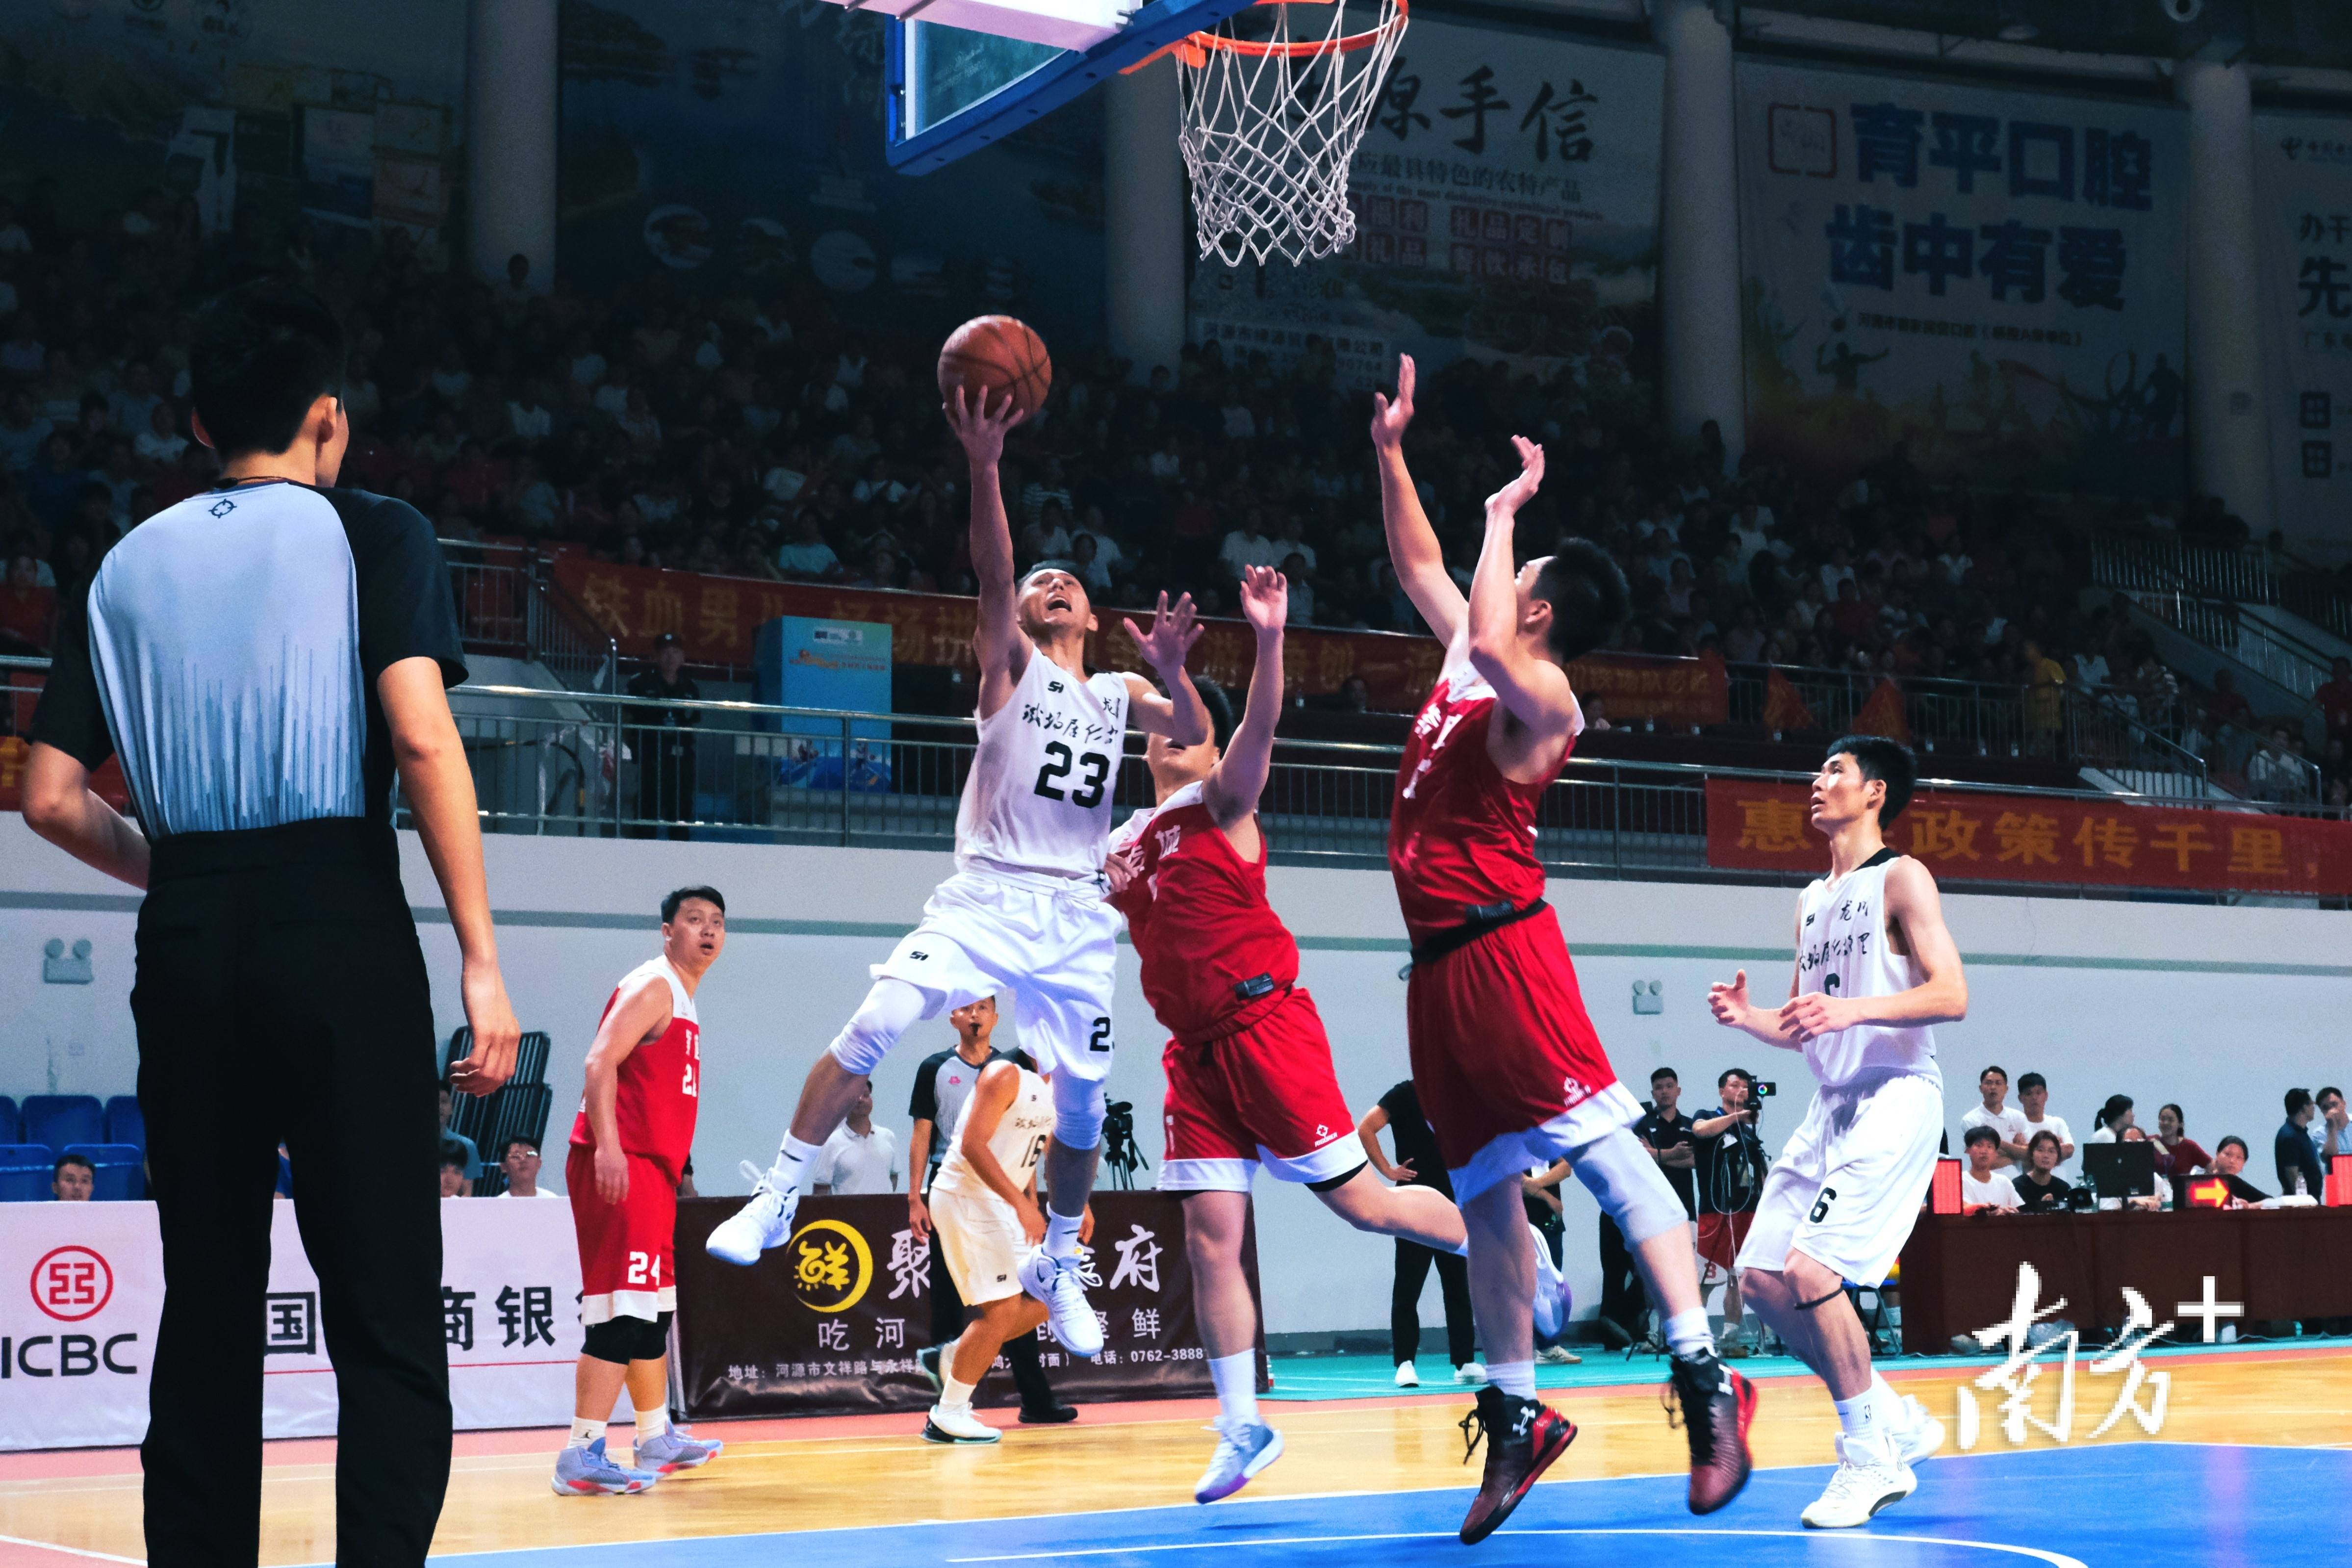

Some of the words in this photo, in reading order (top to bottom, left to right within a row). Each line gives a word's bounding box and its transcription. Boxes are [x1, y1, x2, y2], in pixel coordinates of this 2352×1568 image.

[1271, 37, 1600, 164] 源手信
[1850, 102, 2154, 212] 育平口腔
[1825, 203, 2126, 312] 齿中有爱
[1034, 740, 1111, 809] 23
[1736, 796, 2318, 879] 惠政策传千里，
[1089, 1016, 1116, 1052] 2
[1809, 1187, 1838, 1224] 6
[627, 1251, 661, 1287] 24
[1, 1333, 138, 1380] ICBC
